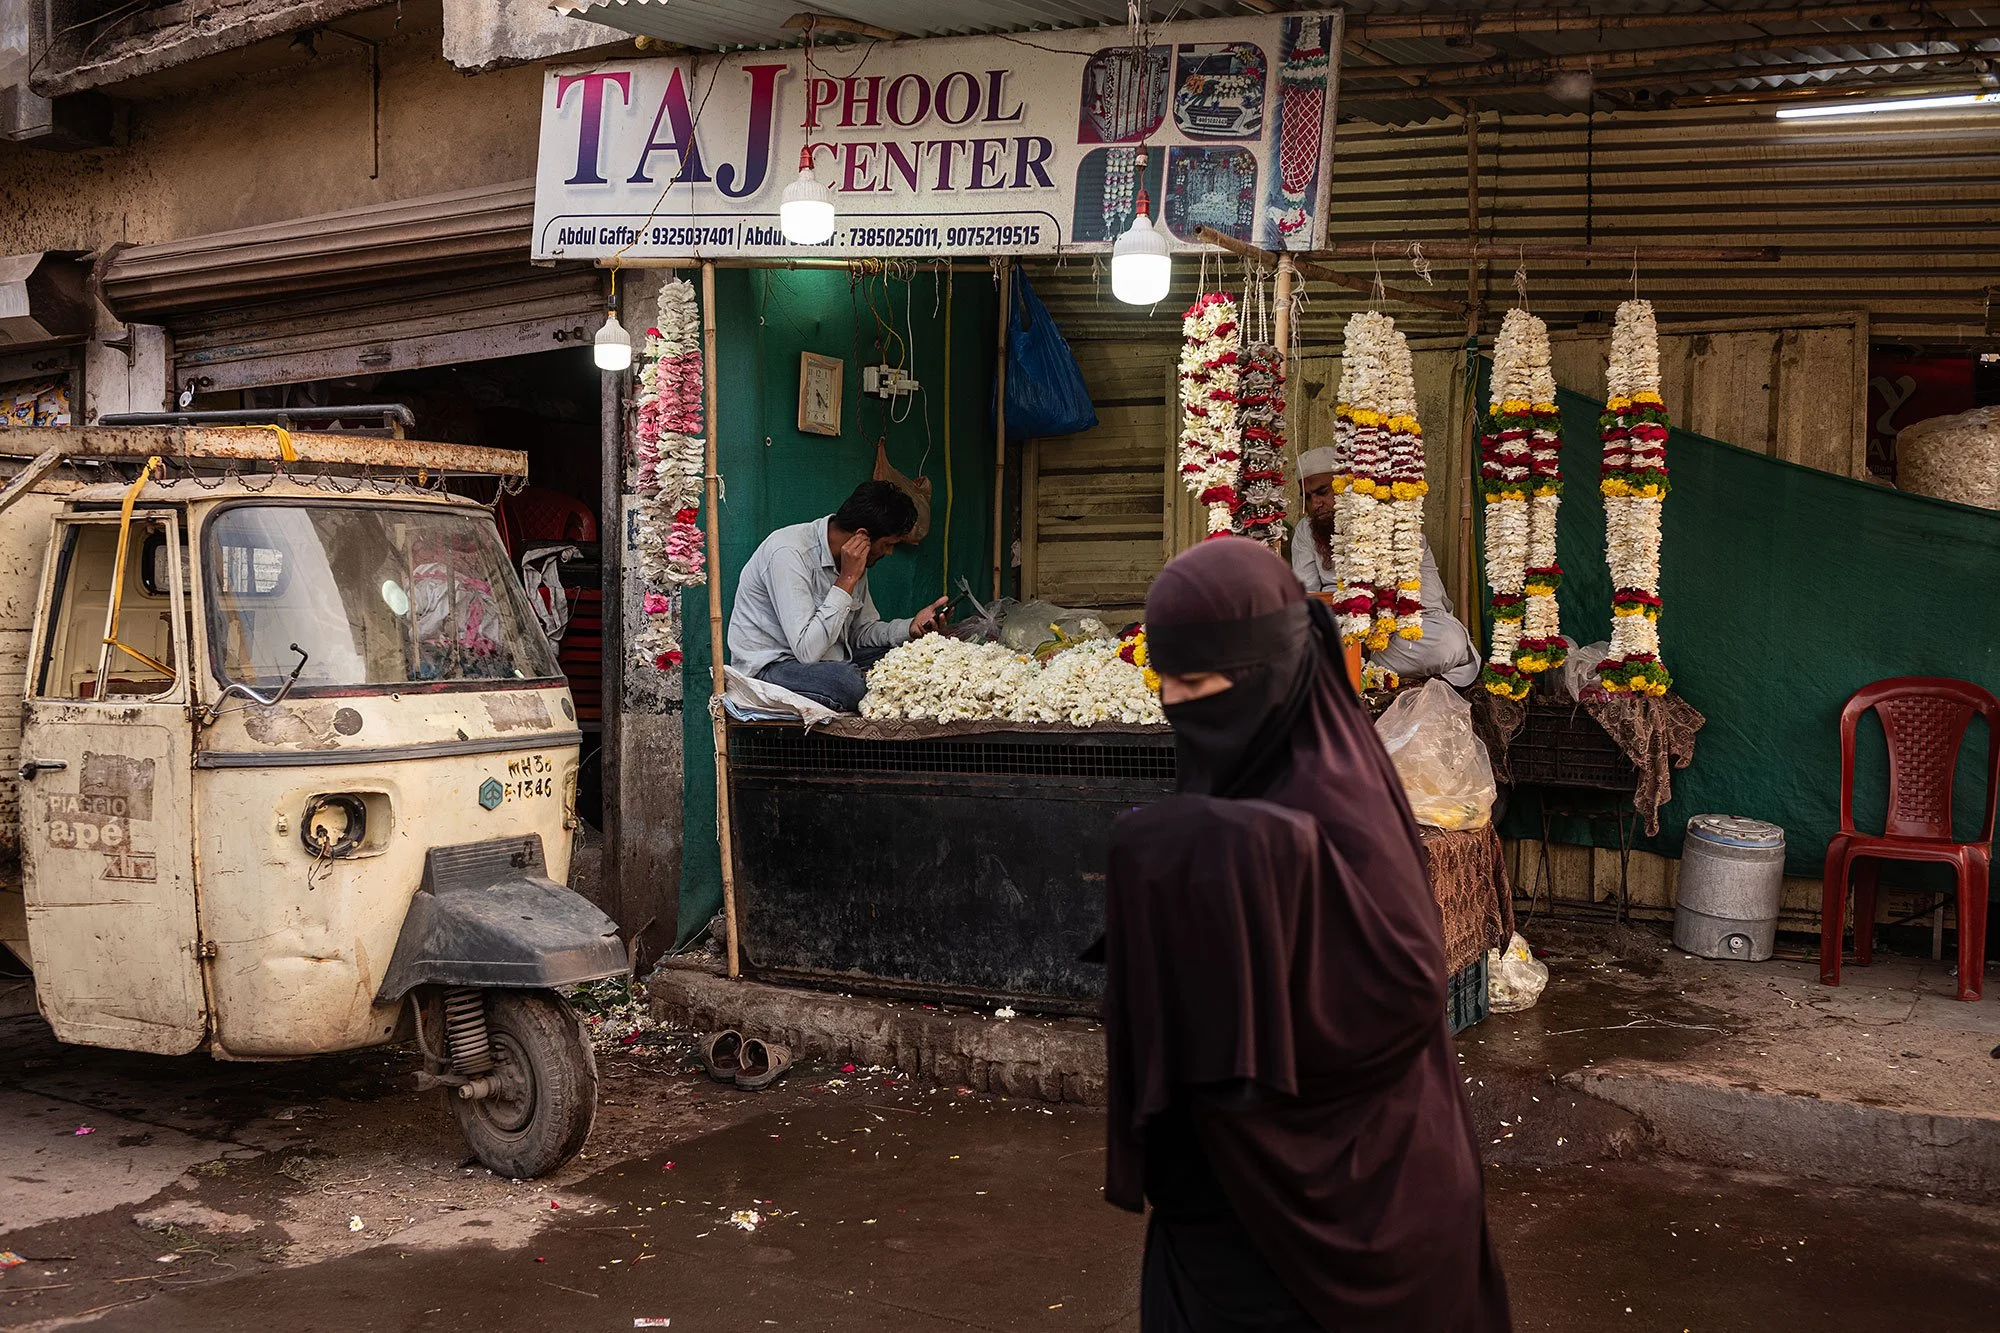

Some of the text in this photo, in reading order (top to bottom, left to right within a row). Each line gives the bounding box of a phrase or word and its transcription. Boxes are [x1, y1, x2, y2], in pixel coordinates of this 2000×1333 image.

[800, 70, 1023, 128] PHOOL
[556, 63, 788, 199] TAJ
[557, 226, 597, 246] Abdul
[599, 226, 642, 246] Gaffar
[652, 227, 734, 246] 9325037401
[849, 227, 942, 249] 7385025011,
[946, 225, 1040, 247] 9075219515
[50, 796, 127, 816] PIAGGIO
